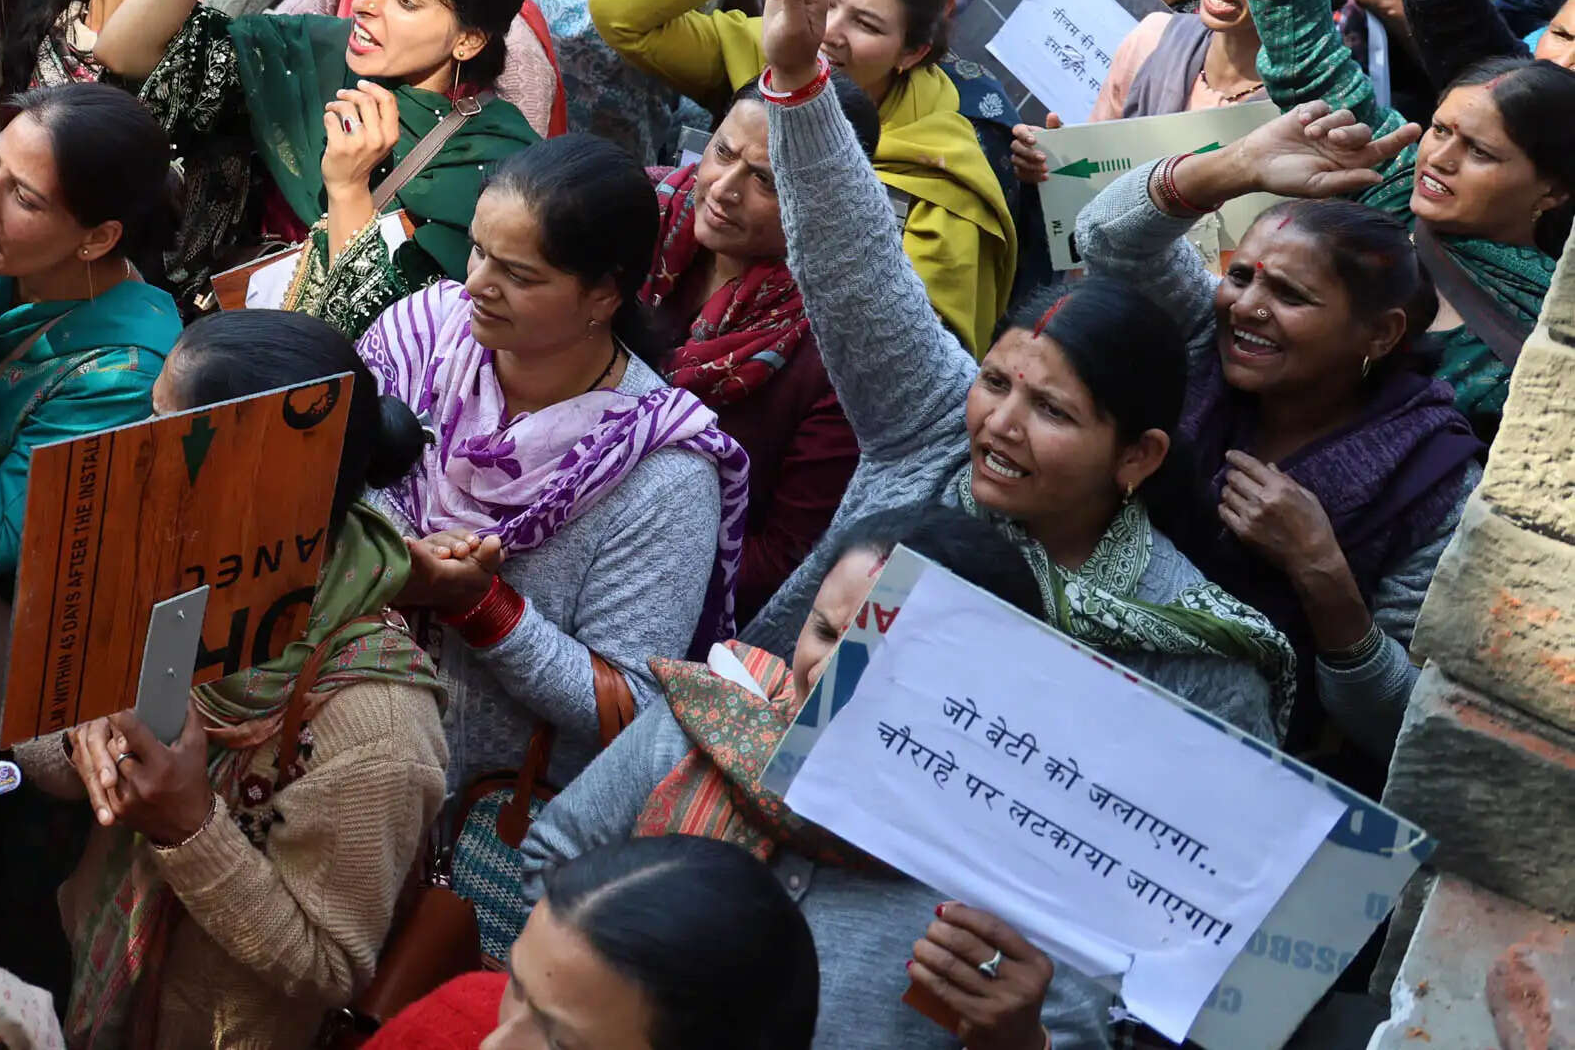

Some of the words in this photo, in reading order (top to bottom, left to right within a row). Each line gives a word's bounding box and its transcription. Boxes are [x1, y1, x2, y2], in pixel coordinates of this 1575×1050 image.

[1052, 7, 1080, 37] नीलम
[1081, 34, 1094, 51] की
[1051, 219, 1063, 237] TM
[74, 503, 94, 538] THE
[68, 540, 88, 589] AFTER
[64, 592, 82, 633] DAYS
[58, 634, 76, 654] 45
[52, 655, 74, 707] WITHIN
[943, 696, 982, 731] जो
[985, 716, 1040, 766] बेटी
[1043, 757, 1084, 791] को
[877, 721, 960, 791] चौराहे
[965, 773, 1005, 811] पर
[1009, 799, 1122, 878] लटकाया
[1126, 869, 1233, 946] जाएगा!
